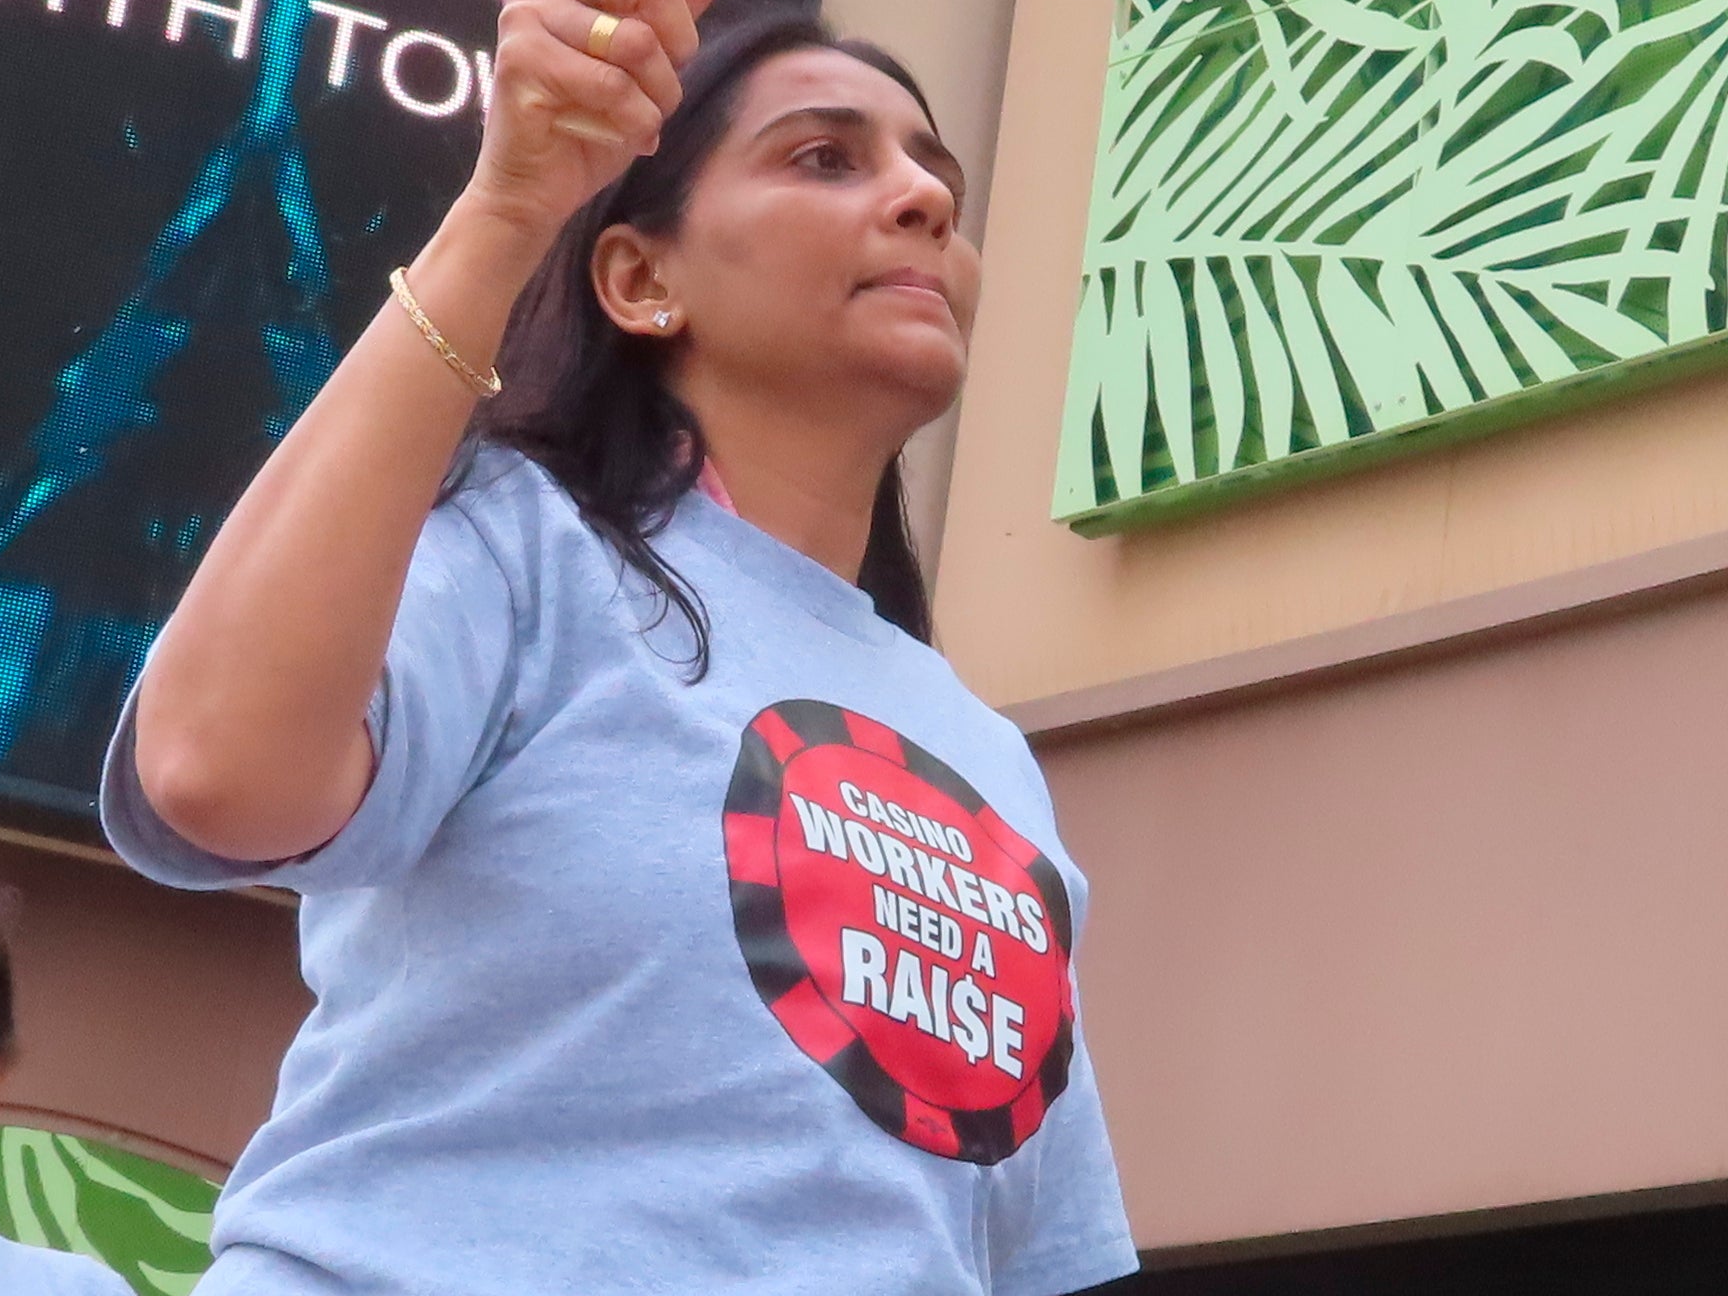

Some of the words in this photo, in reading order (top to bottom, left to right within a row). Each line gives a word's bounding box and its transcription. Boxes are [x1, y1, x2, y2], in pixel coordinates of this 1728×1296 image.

[310, 1, 494, 126] TO
[790, 792, 1048, 954] WORKERS
[840, 781, 972, 862] CASINO
[873, 885, 963, 960] NEED
[972, 930, 996, 979] A
[841, 928, 1024, 1079] RAI$E
